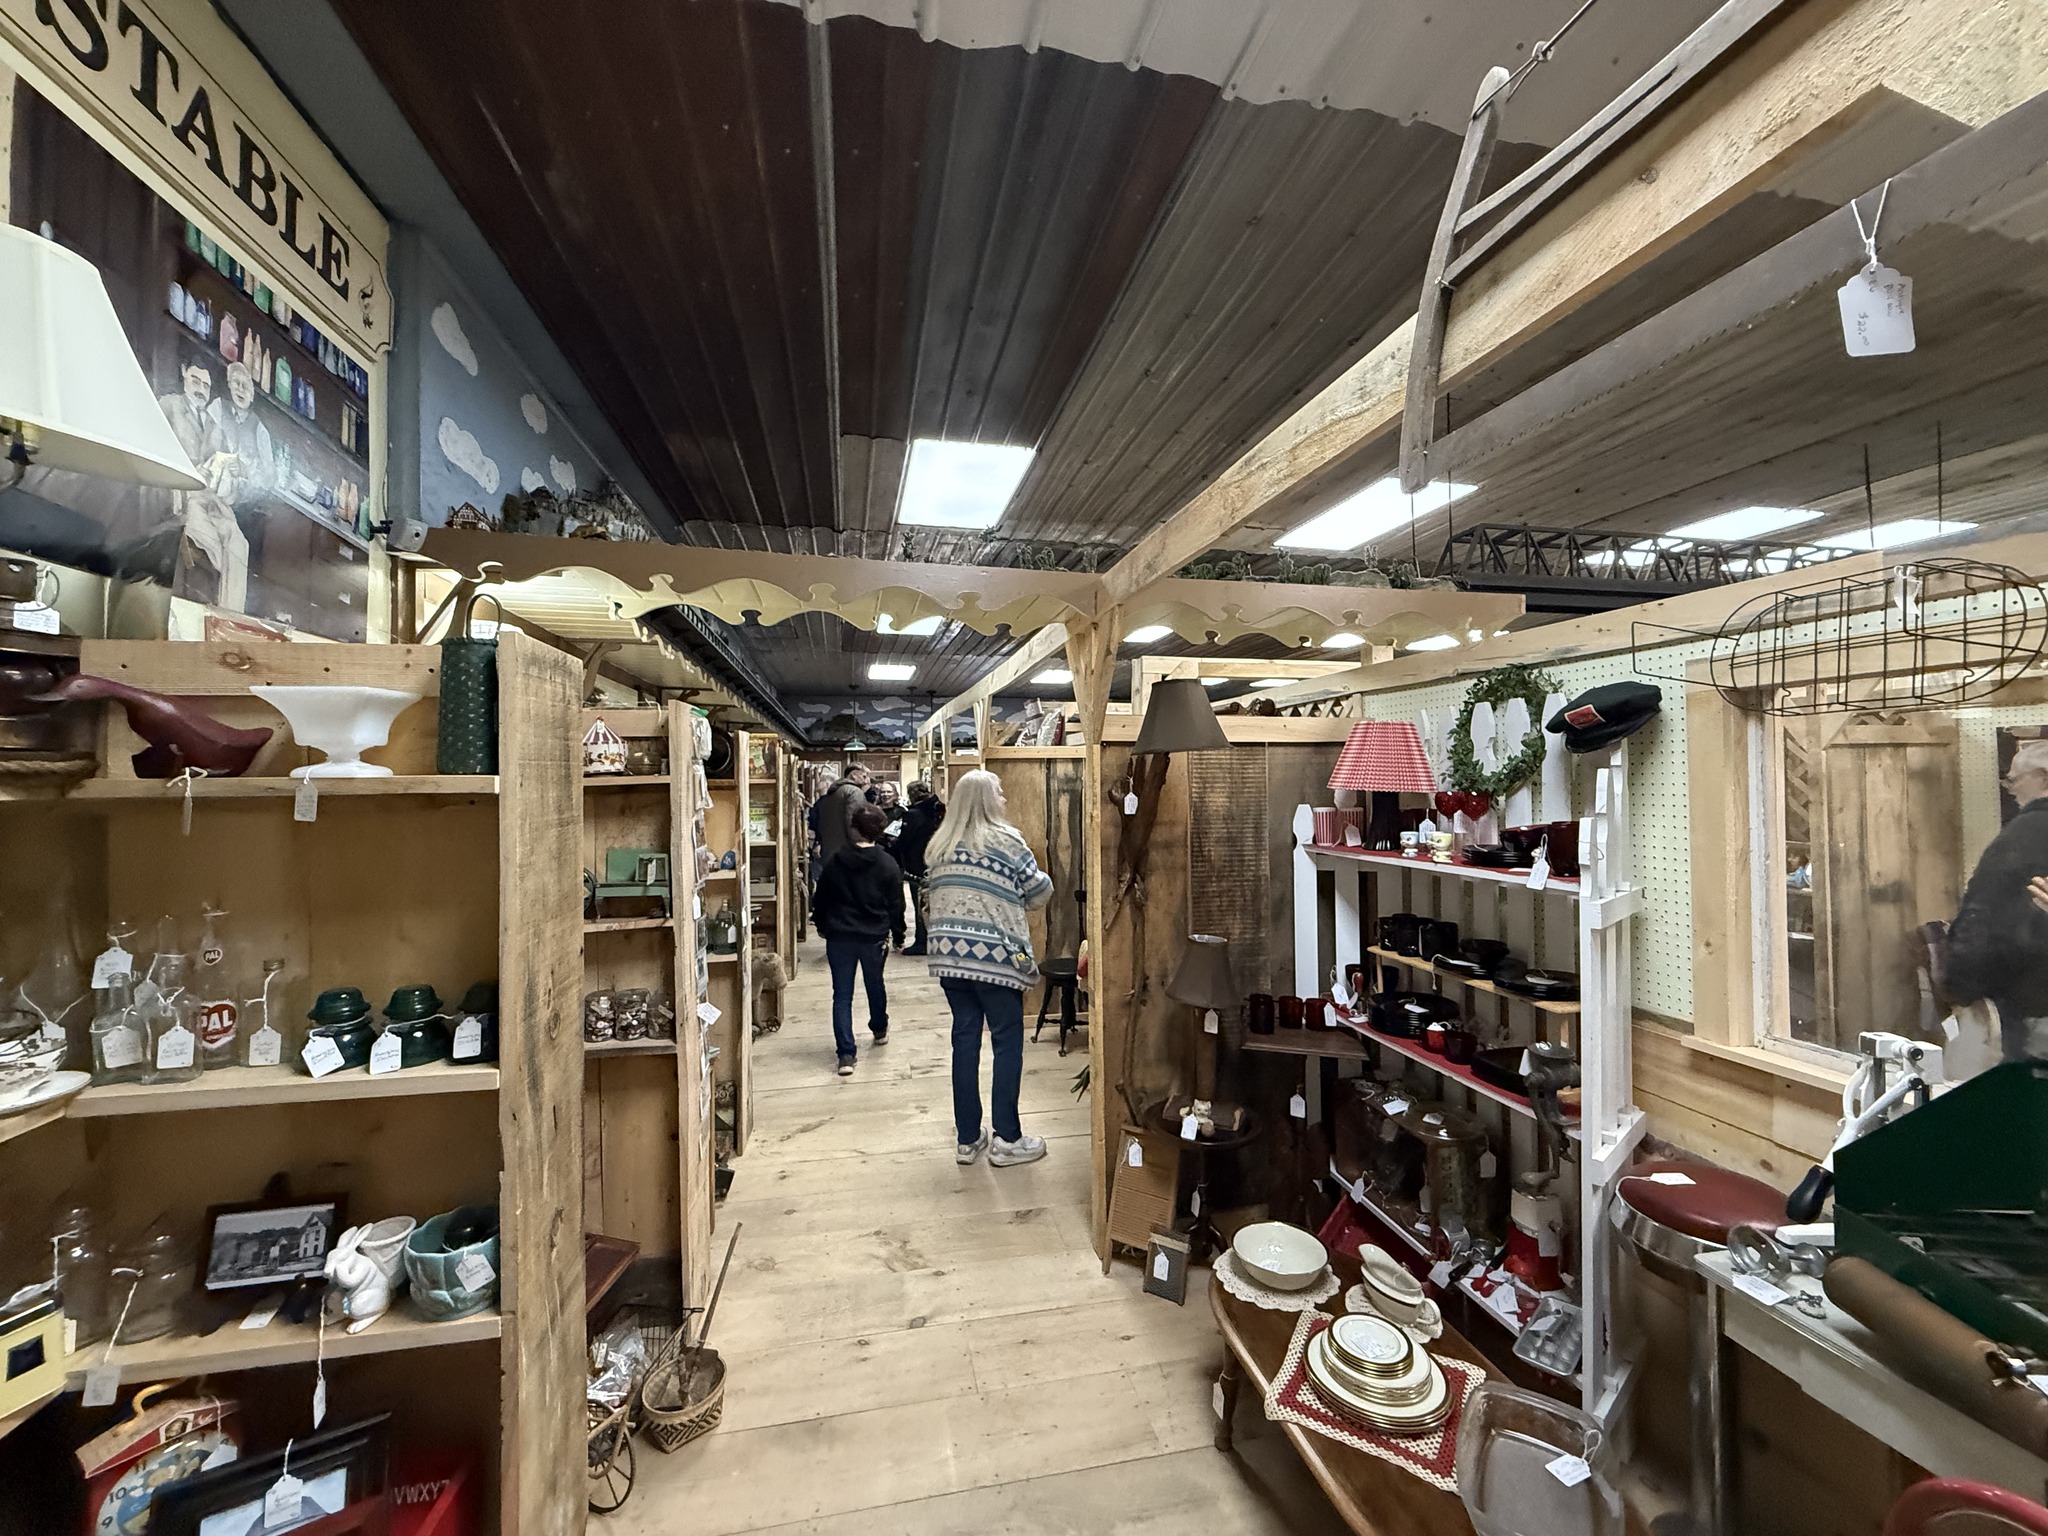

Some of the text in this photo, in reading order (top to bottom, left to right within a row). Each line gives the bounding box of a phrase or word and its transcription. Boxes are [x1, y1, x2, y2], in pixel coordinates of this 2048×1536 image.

[35, 0, 351, 303] STABLE
[205, 951, 219, 961] PAL
[109, 1487, 127, 1504] 10
[102, 1516, 113, 1529] 9
